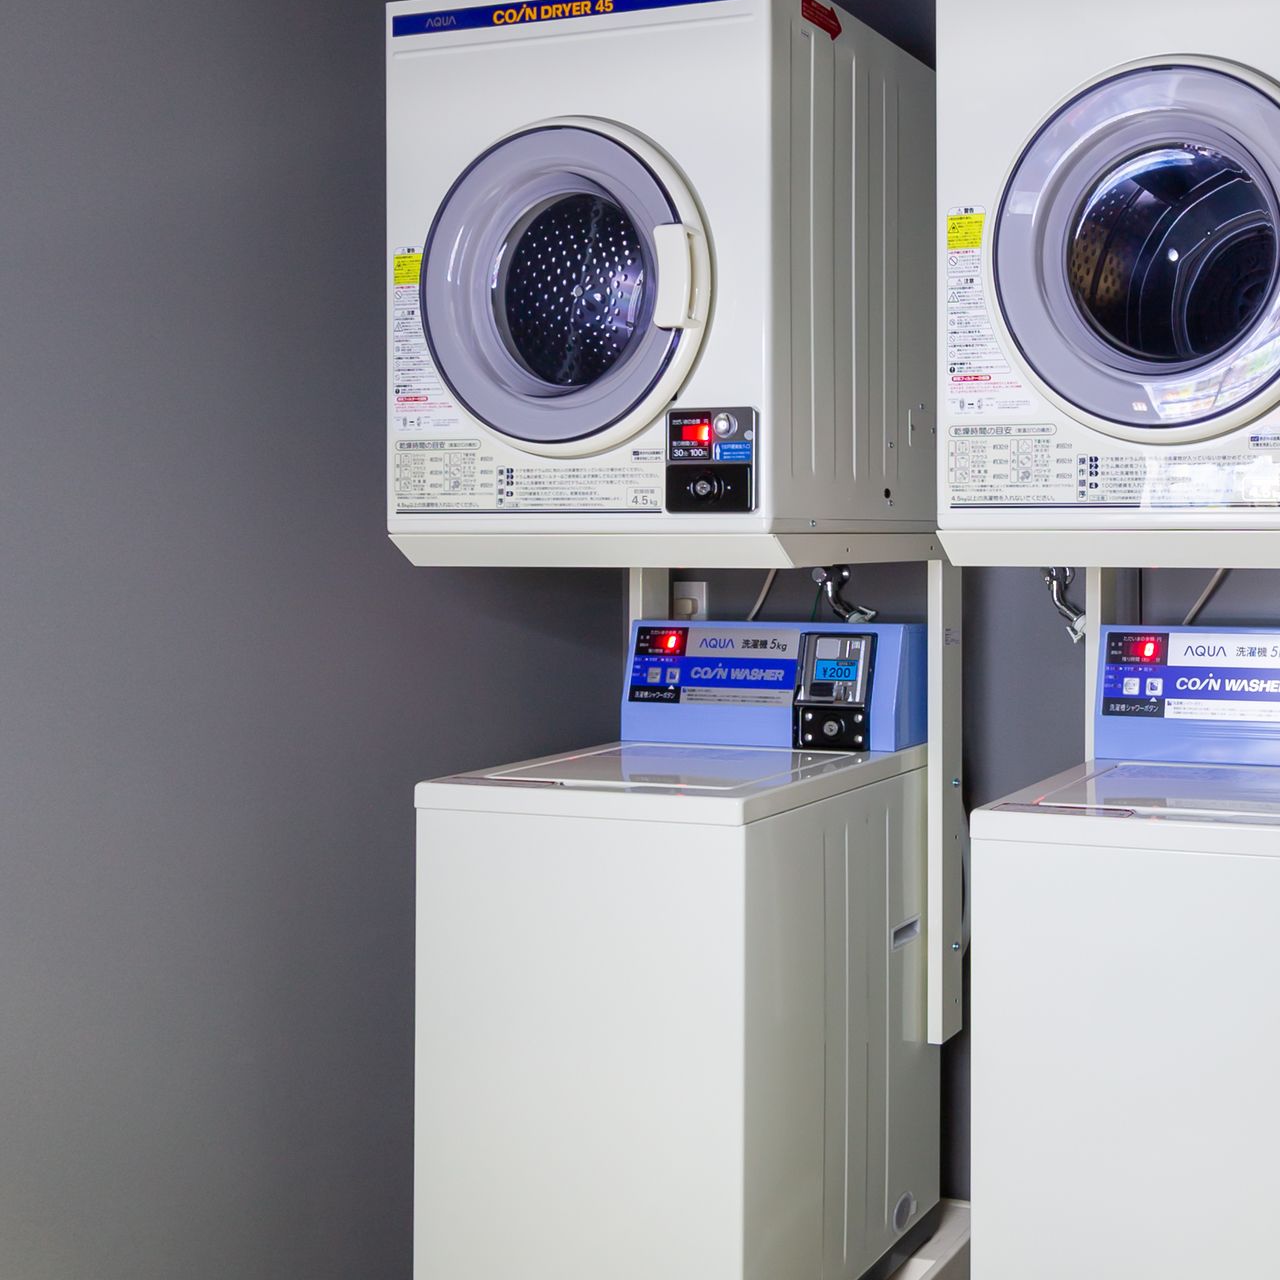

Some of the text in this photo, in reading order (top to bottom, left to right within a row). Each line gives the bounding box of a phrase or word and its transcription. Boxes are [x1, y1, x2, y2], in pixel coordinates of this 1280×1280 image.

[425, 15, 457, 27] AQUA
[541, 2, 592, 20] DRYER
[699, 637, 788, 653] AQUA 洗濯機 5kg
[1183, 645, 1227, 658] AQUA
[1235, 646, 1268, 658] 洗濯機
[730, 667, 785, 682] WASHER
[821, 666, 851, 679] ¥200
